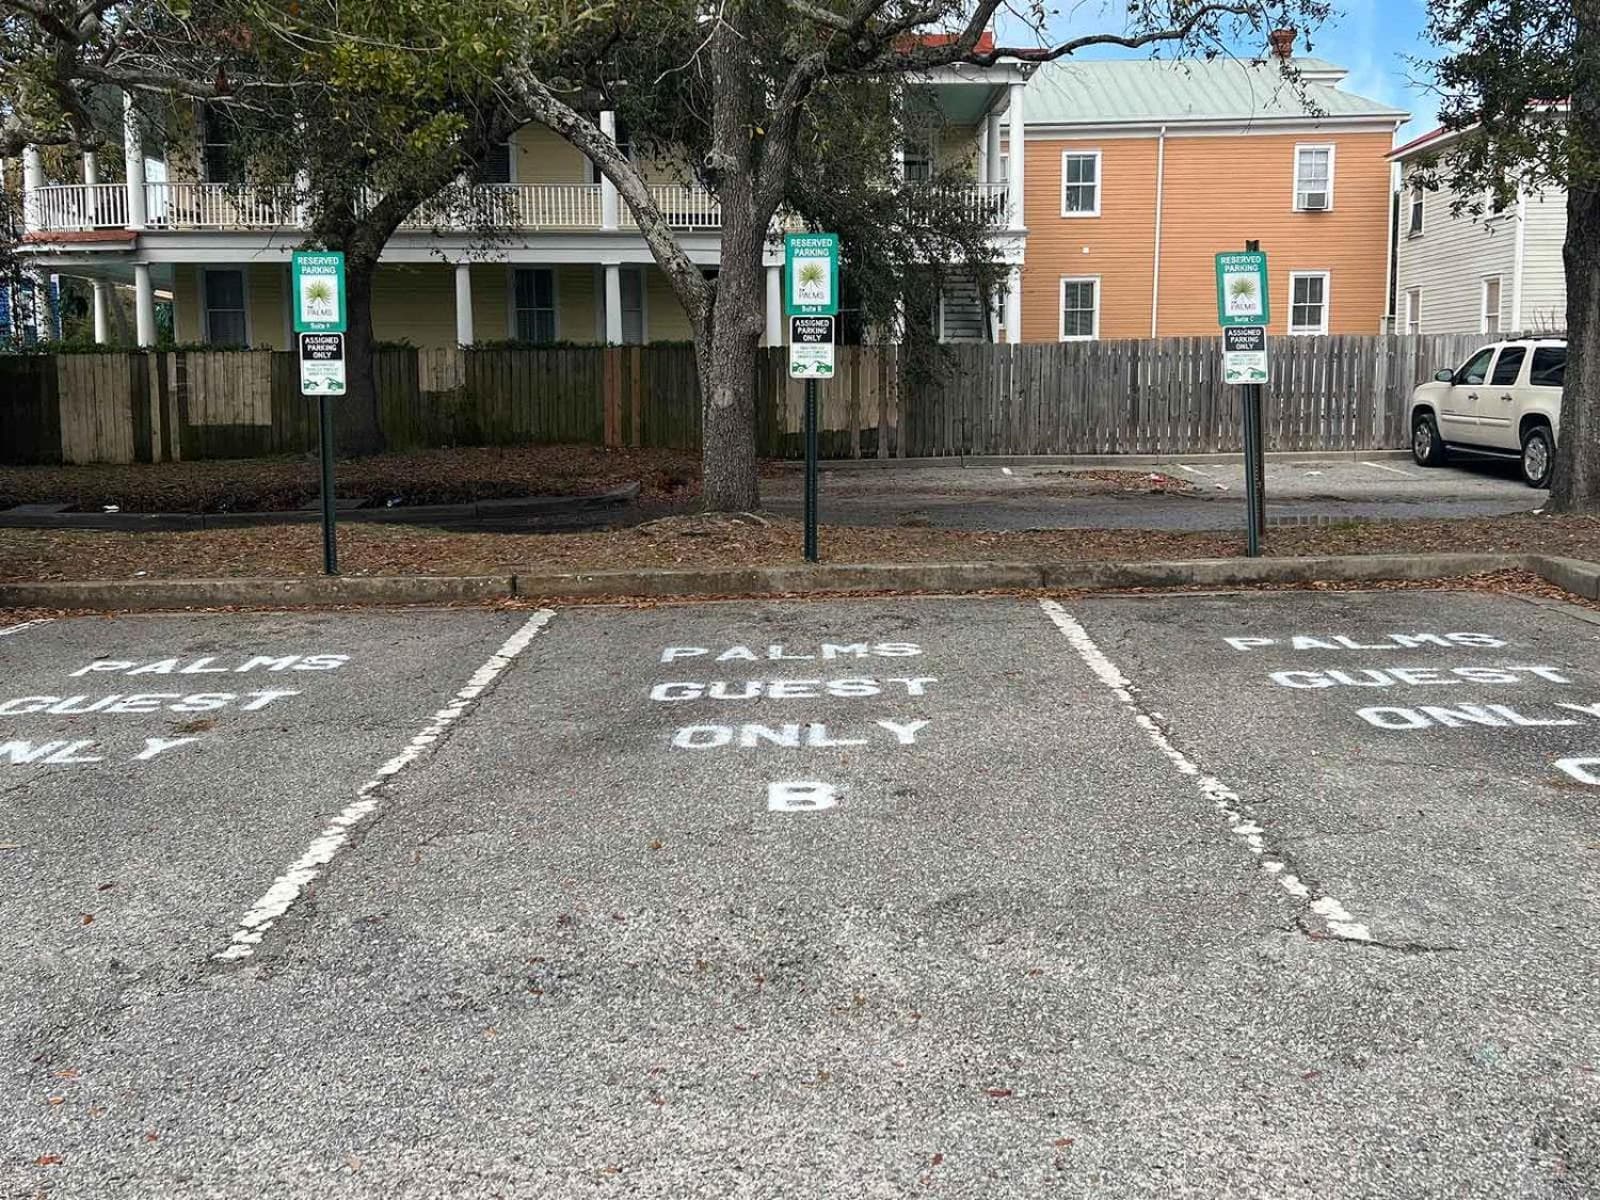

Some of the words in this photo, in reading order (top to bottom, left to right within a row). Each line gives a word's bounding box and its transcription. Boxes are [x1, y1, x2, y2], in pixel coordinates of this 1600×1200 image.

[790, 239, 833, 247] RESERVED
[794, 248, 829, 256] PARKING
[298, 256, 339, 265] RESERVED
[1220, 256, 1262, 264] RESERVED
[301, 266, 336, 274] PARKING
[1224, 264, 1259, 272] PARKING
[799, 291, 825, 299] PALMS
[307, 308, 333, 316] PALMS
[795, 319, 830, 327] ASSIGNED
[797, 327, 828, 335] PARKING
[1227, 329, 1261, 337] ASSIGNED
[305, 336, 339, 344] ASSIGNED
[1230, 336, 1259, 344] PARKING
[312, 351, 332, 359] ONLY
[1223, 632, 1507, 650] PALMS
[660, 642, 923, 663] PALMS
[68, 654, 350, 677] PALMS
[1268, 666, 1572, 688] GUEST
[650, 677, 939, 701] GUEST
[0, 687, 302, 715] GUEST
[671, 717, 932, 749] ONLY
[0, 737, 201, 763] NLY
[767, 781, 839, 812] B
